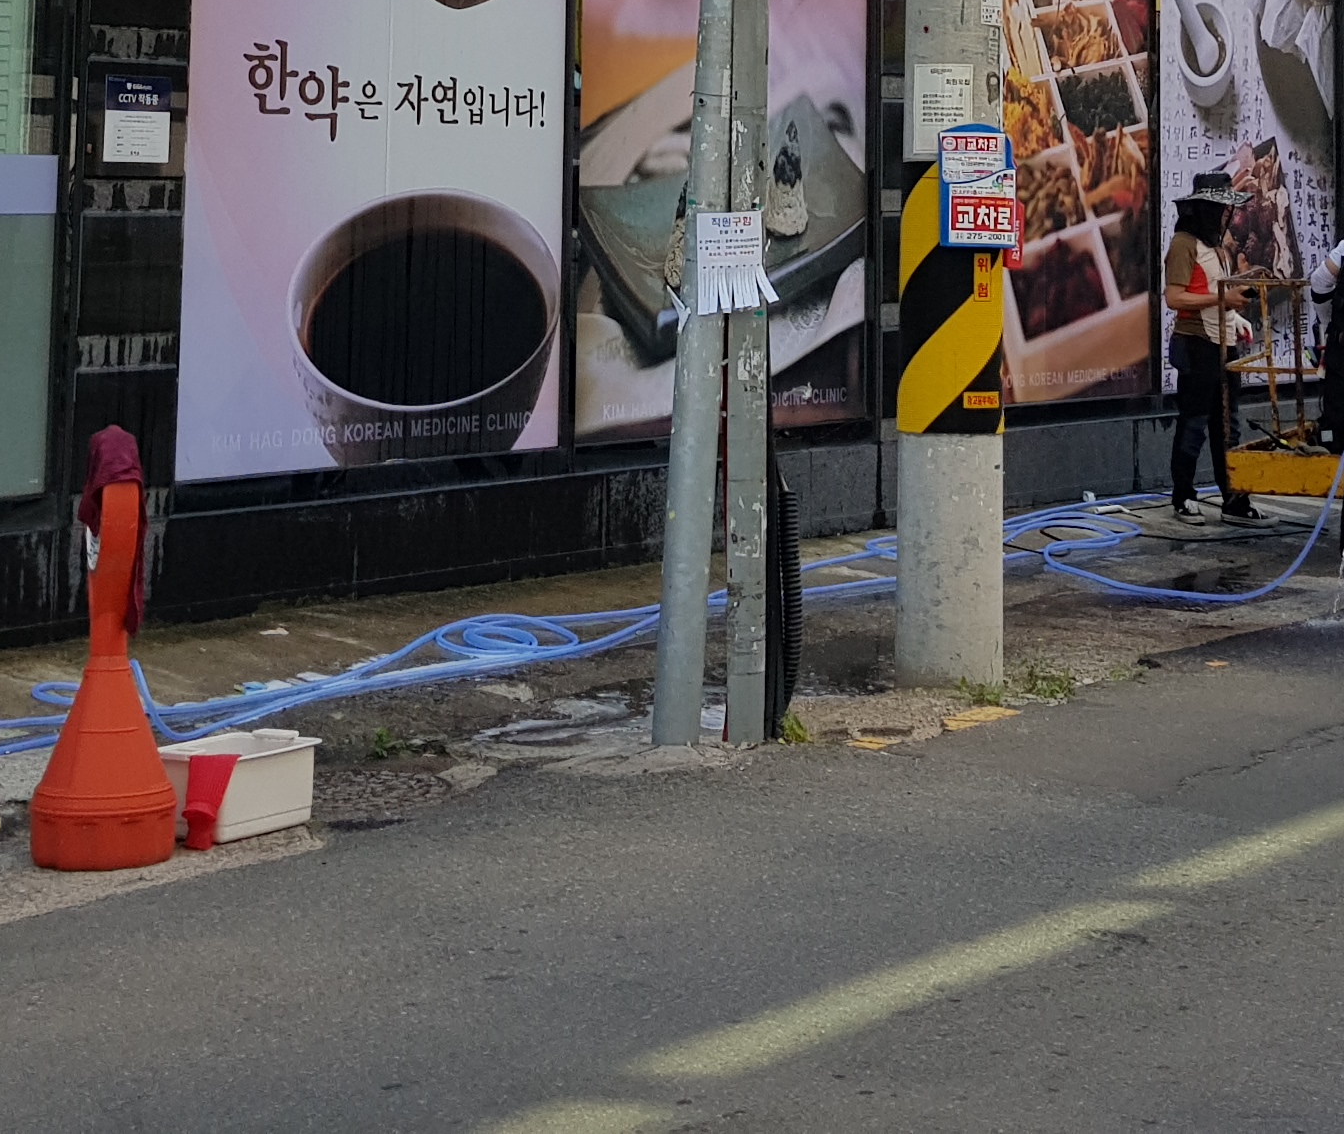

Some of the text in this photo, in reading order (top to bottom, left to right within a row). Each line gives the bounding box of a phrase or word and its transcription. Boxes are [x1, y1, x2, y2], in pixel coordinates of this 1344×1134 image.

[118, 93, 137, 103] CCTV
[243, 39, 383, 142] 한약은
[394, 74, 545, 128] 자연입니다!
[956, 205, 1012, 230] 교차로
[1029, 372, 1064, 387] KOREAN
[1067, 368, 1107, 384] MEDICINE
[812, 386, 848, 404] CLINIC
[212, 411, 533, 452] KIM HAG DONG KOREAN MEDICINE CLINIC
